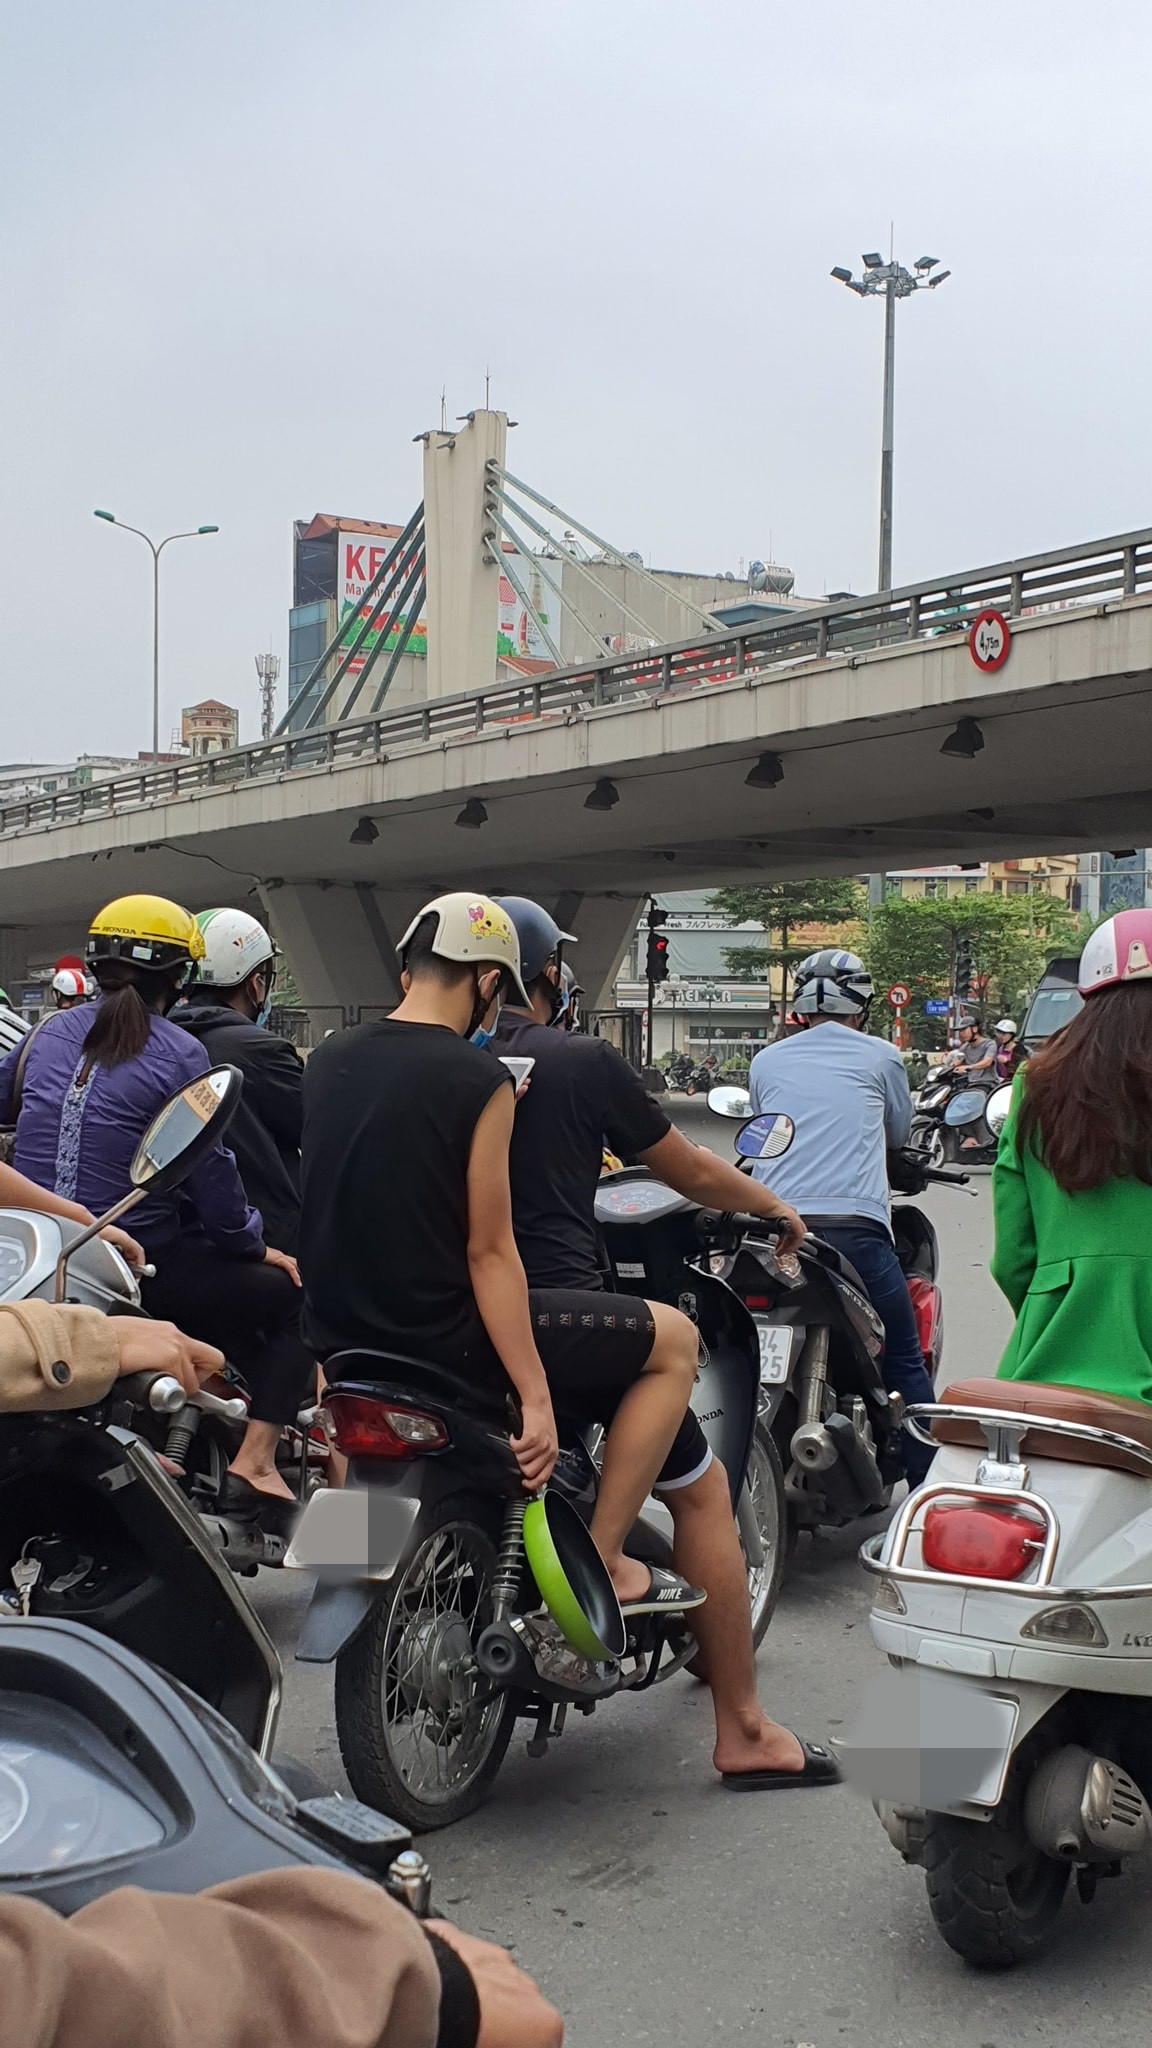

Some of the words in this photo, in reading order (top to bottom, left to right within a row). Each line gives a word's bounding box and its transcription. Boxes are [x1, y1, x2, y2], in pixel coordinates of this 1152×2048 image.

[980, 631, 1000, 655] 4,75m
[102, 926, 137, 935] HONDA
[696, 1408, 725, 1424] ONDA
[656, 1587, 683, 1601] NIKE
